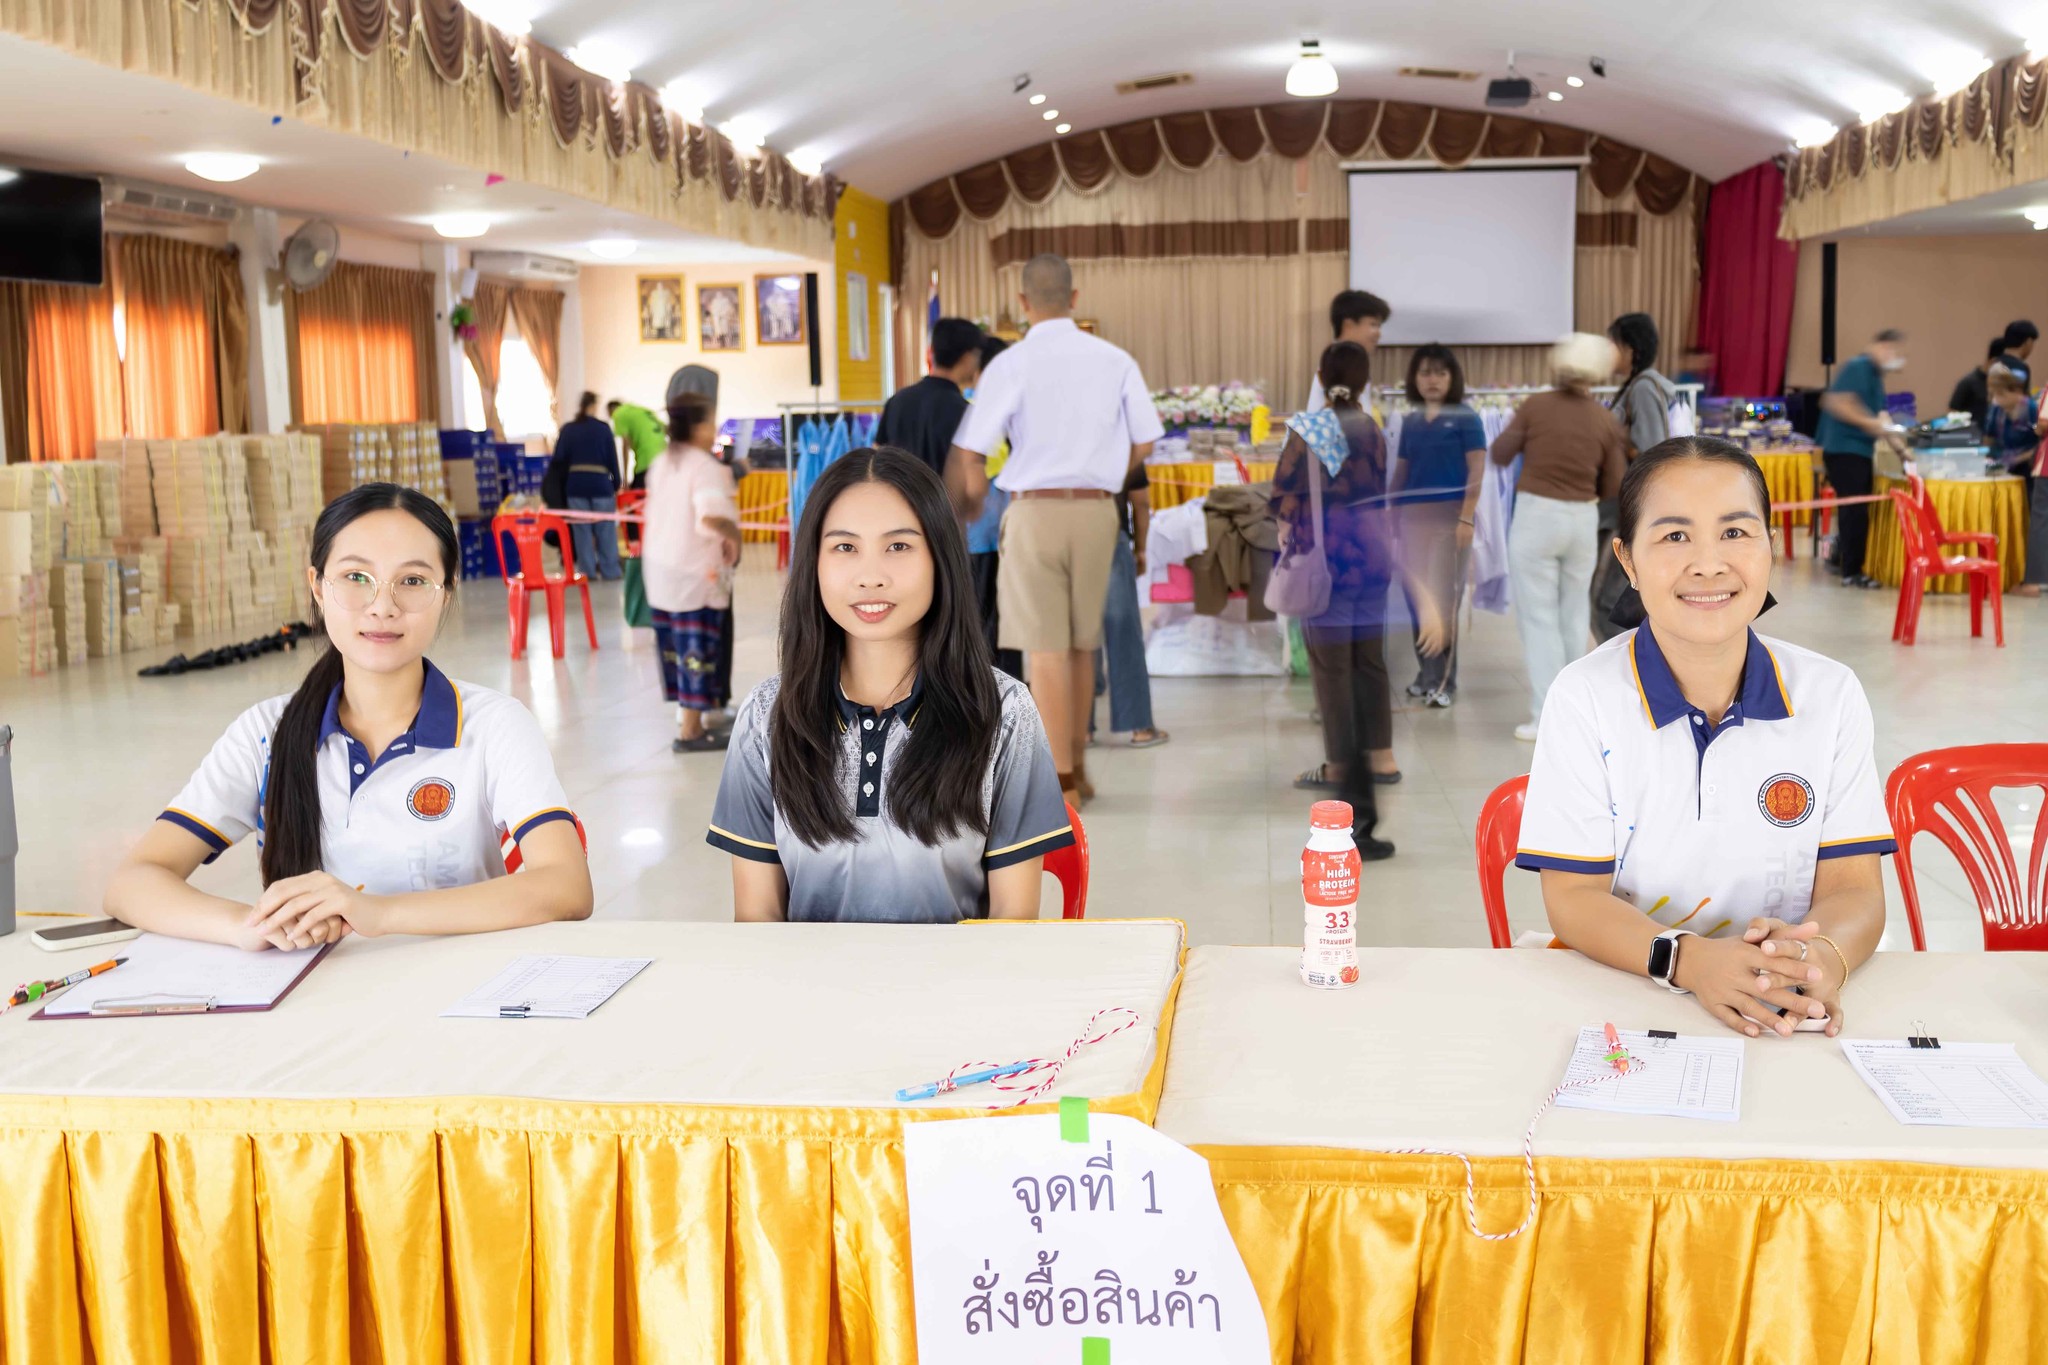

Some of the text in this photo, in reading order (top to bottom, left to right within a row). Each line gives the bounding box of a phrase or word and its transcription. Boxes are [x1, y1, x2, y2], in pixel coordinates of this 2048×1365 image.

[406, 839, 428, 891] TEC
[1327, 868, 1351, 878] HIGH
[1319, 878, 1356, 889] PROTEIN
[1325, 911, 1349, 928] 33
[1319, 937, 1353, 946] STRAWBERRY
[1011, 1140, 1163, 1233] จุดที่ 1
[962, 1250, 1222, 1335] สั่งซื้อสินค้า
